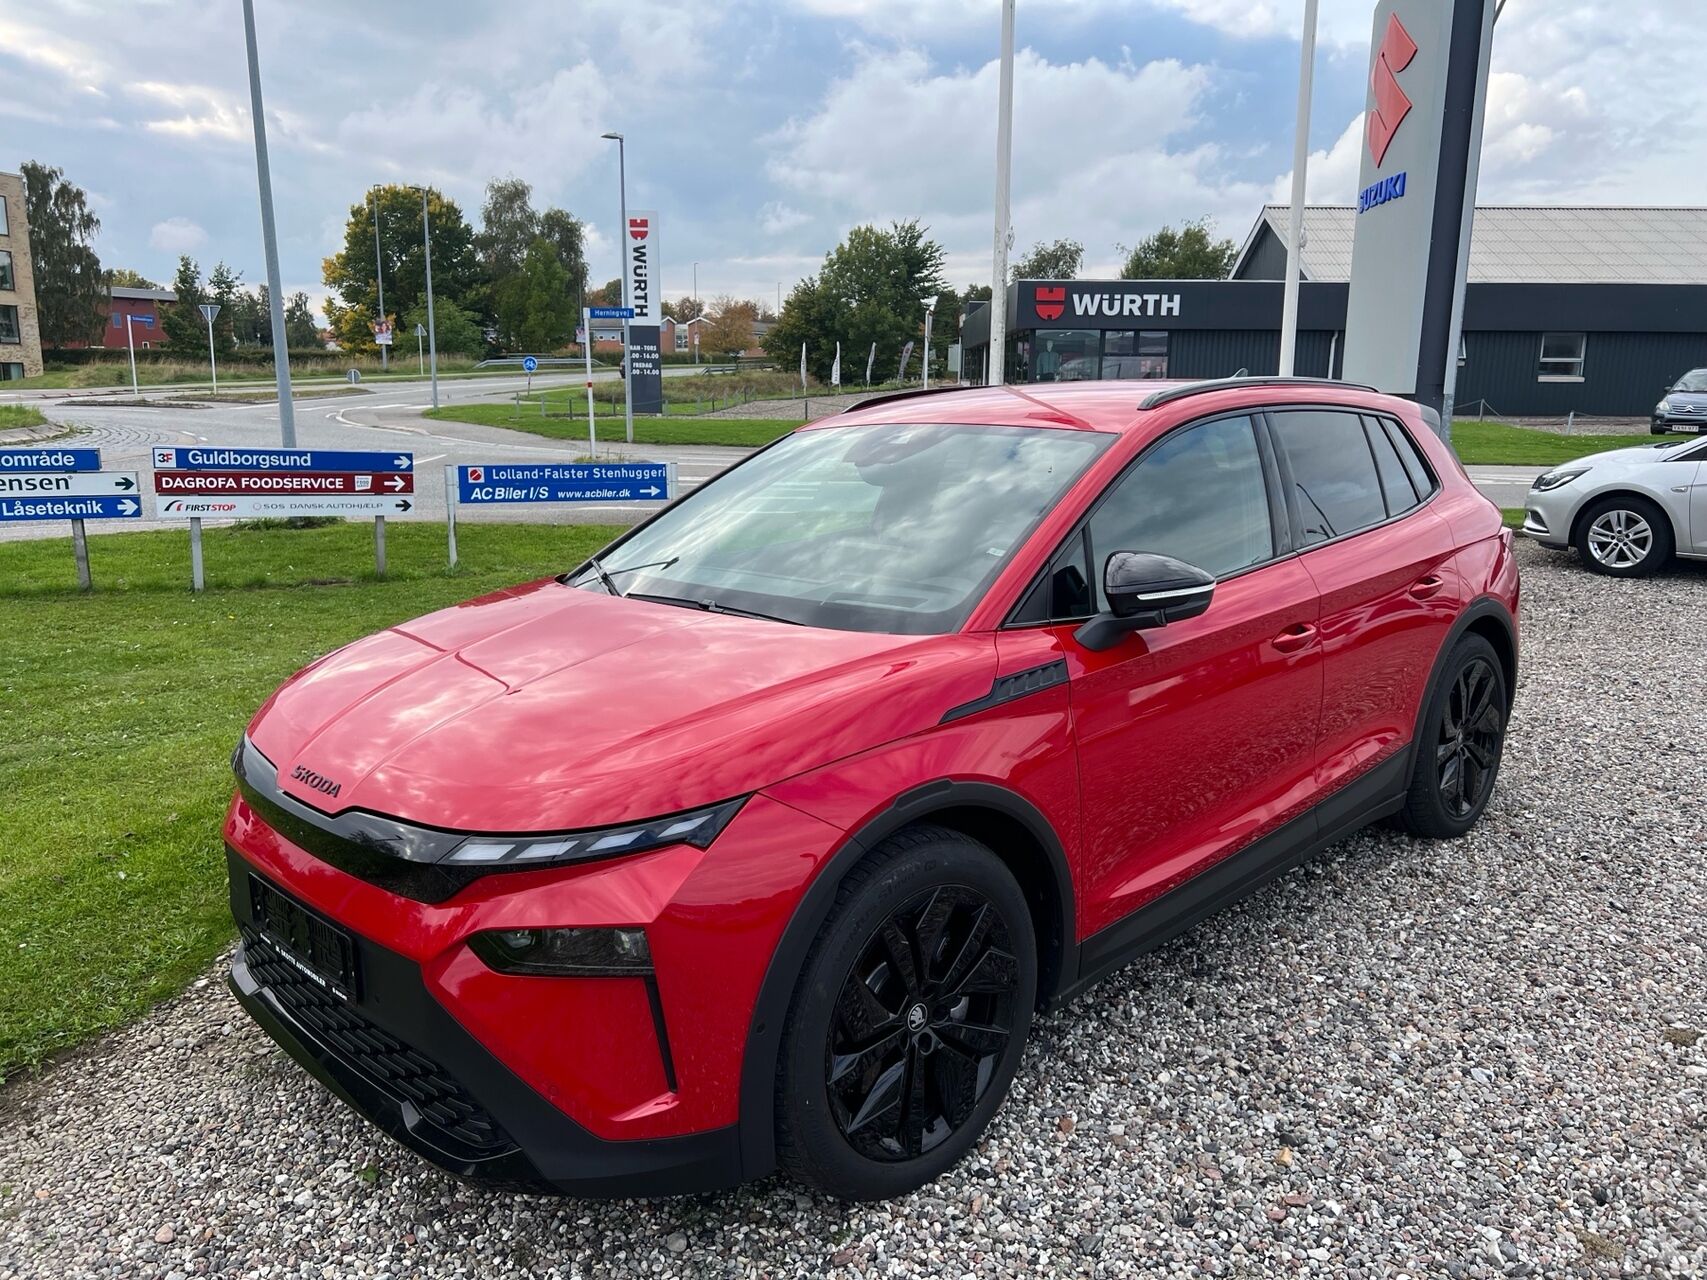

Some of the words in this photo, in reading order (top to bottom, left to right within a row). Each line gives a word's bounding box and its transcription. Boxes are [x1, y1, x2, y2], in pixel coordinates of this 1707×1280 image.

[1360, 171, 1407, 214] SUZUKI
[632, 244, 649, 318] WÜRTH
[1072, 293, 1181, 316] WÜRTH
[594, 309, 630, 318] Herningvej
[0, 450, 76, 467] område
[157, 453, 173, 463] 3F
[188, 450, 311, 468] Guldborgsund
[492, 468, 589, 480] Lolland-Falster
[593, 467, 666, 480] Stenhuggeri
[162, 477, 238, 489] DAGROFA
[241, 478, 344, 489] FOODSERVICE
[470, 487, 493, 500] AC
[494, 486, 527, 500] Biler
[529, 486, 549, 500] I/S
[557, 488, 631, 499] www.acbiler.dk
[1, 500, 104, 516] Låseteknik
